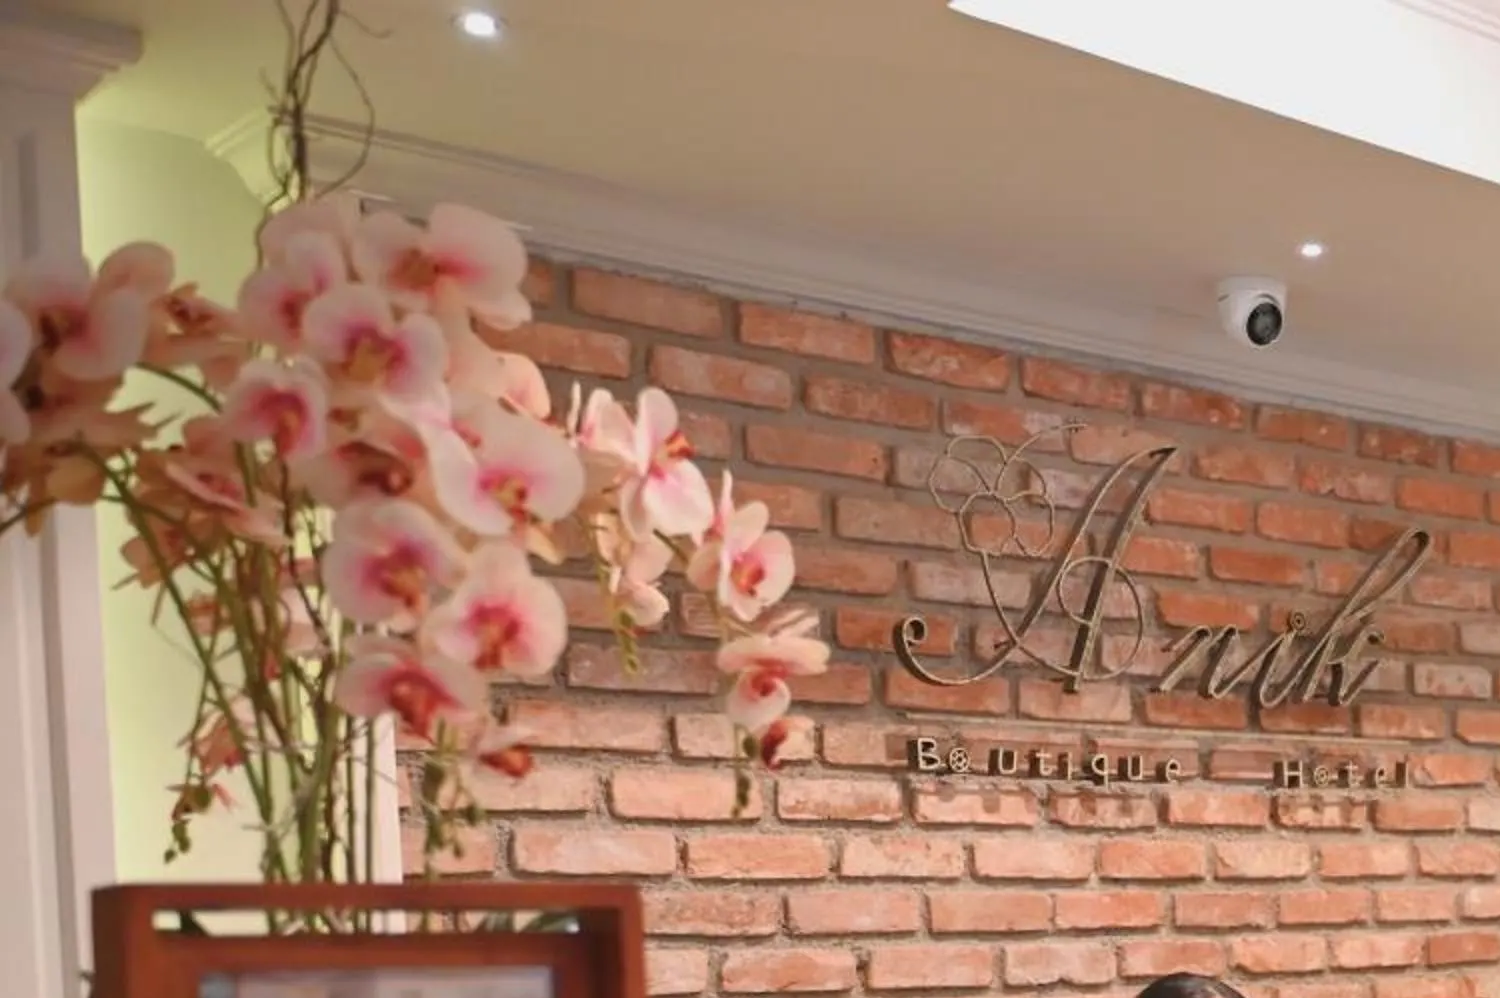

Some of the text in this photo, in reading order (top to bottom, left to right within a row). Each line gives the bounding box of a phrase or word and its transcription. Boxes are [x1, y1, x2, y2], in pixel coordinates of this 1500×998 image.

[895, 422, 1431, 707] Anik
[916, 737, 1409, 788] Boutique Hotel
